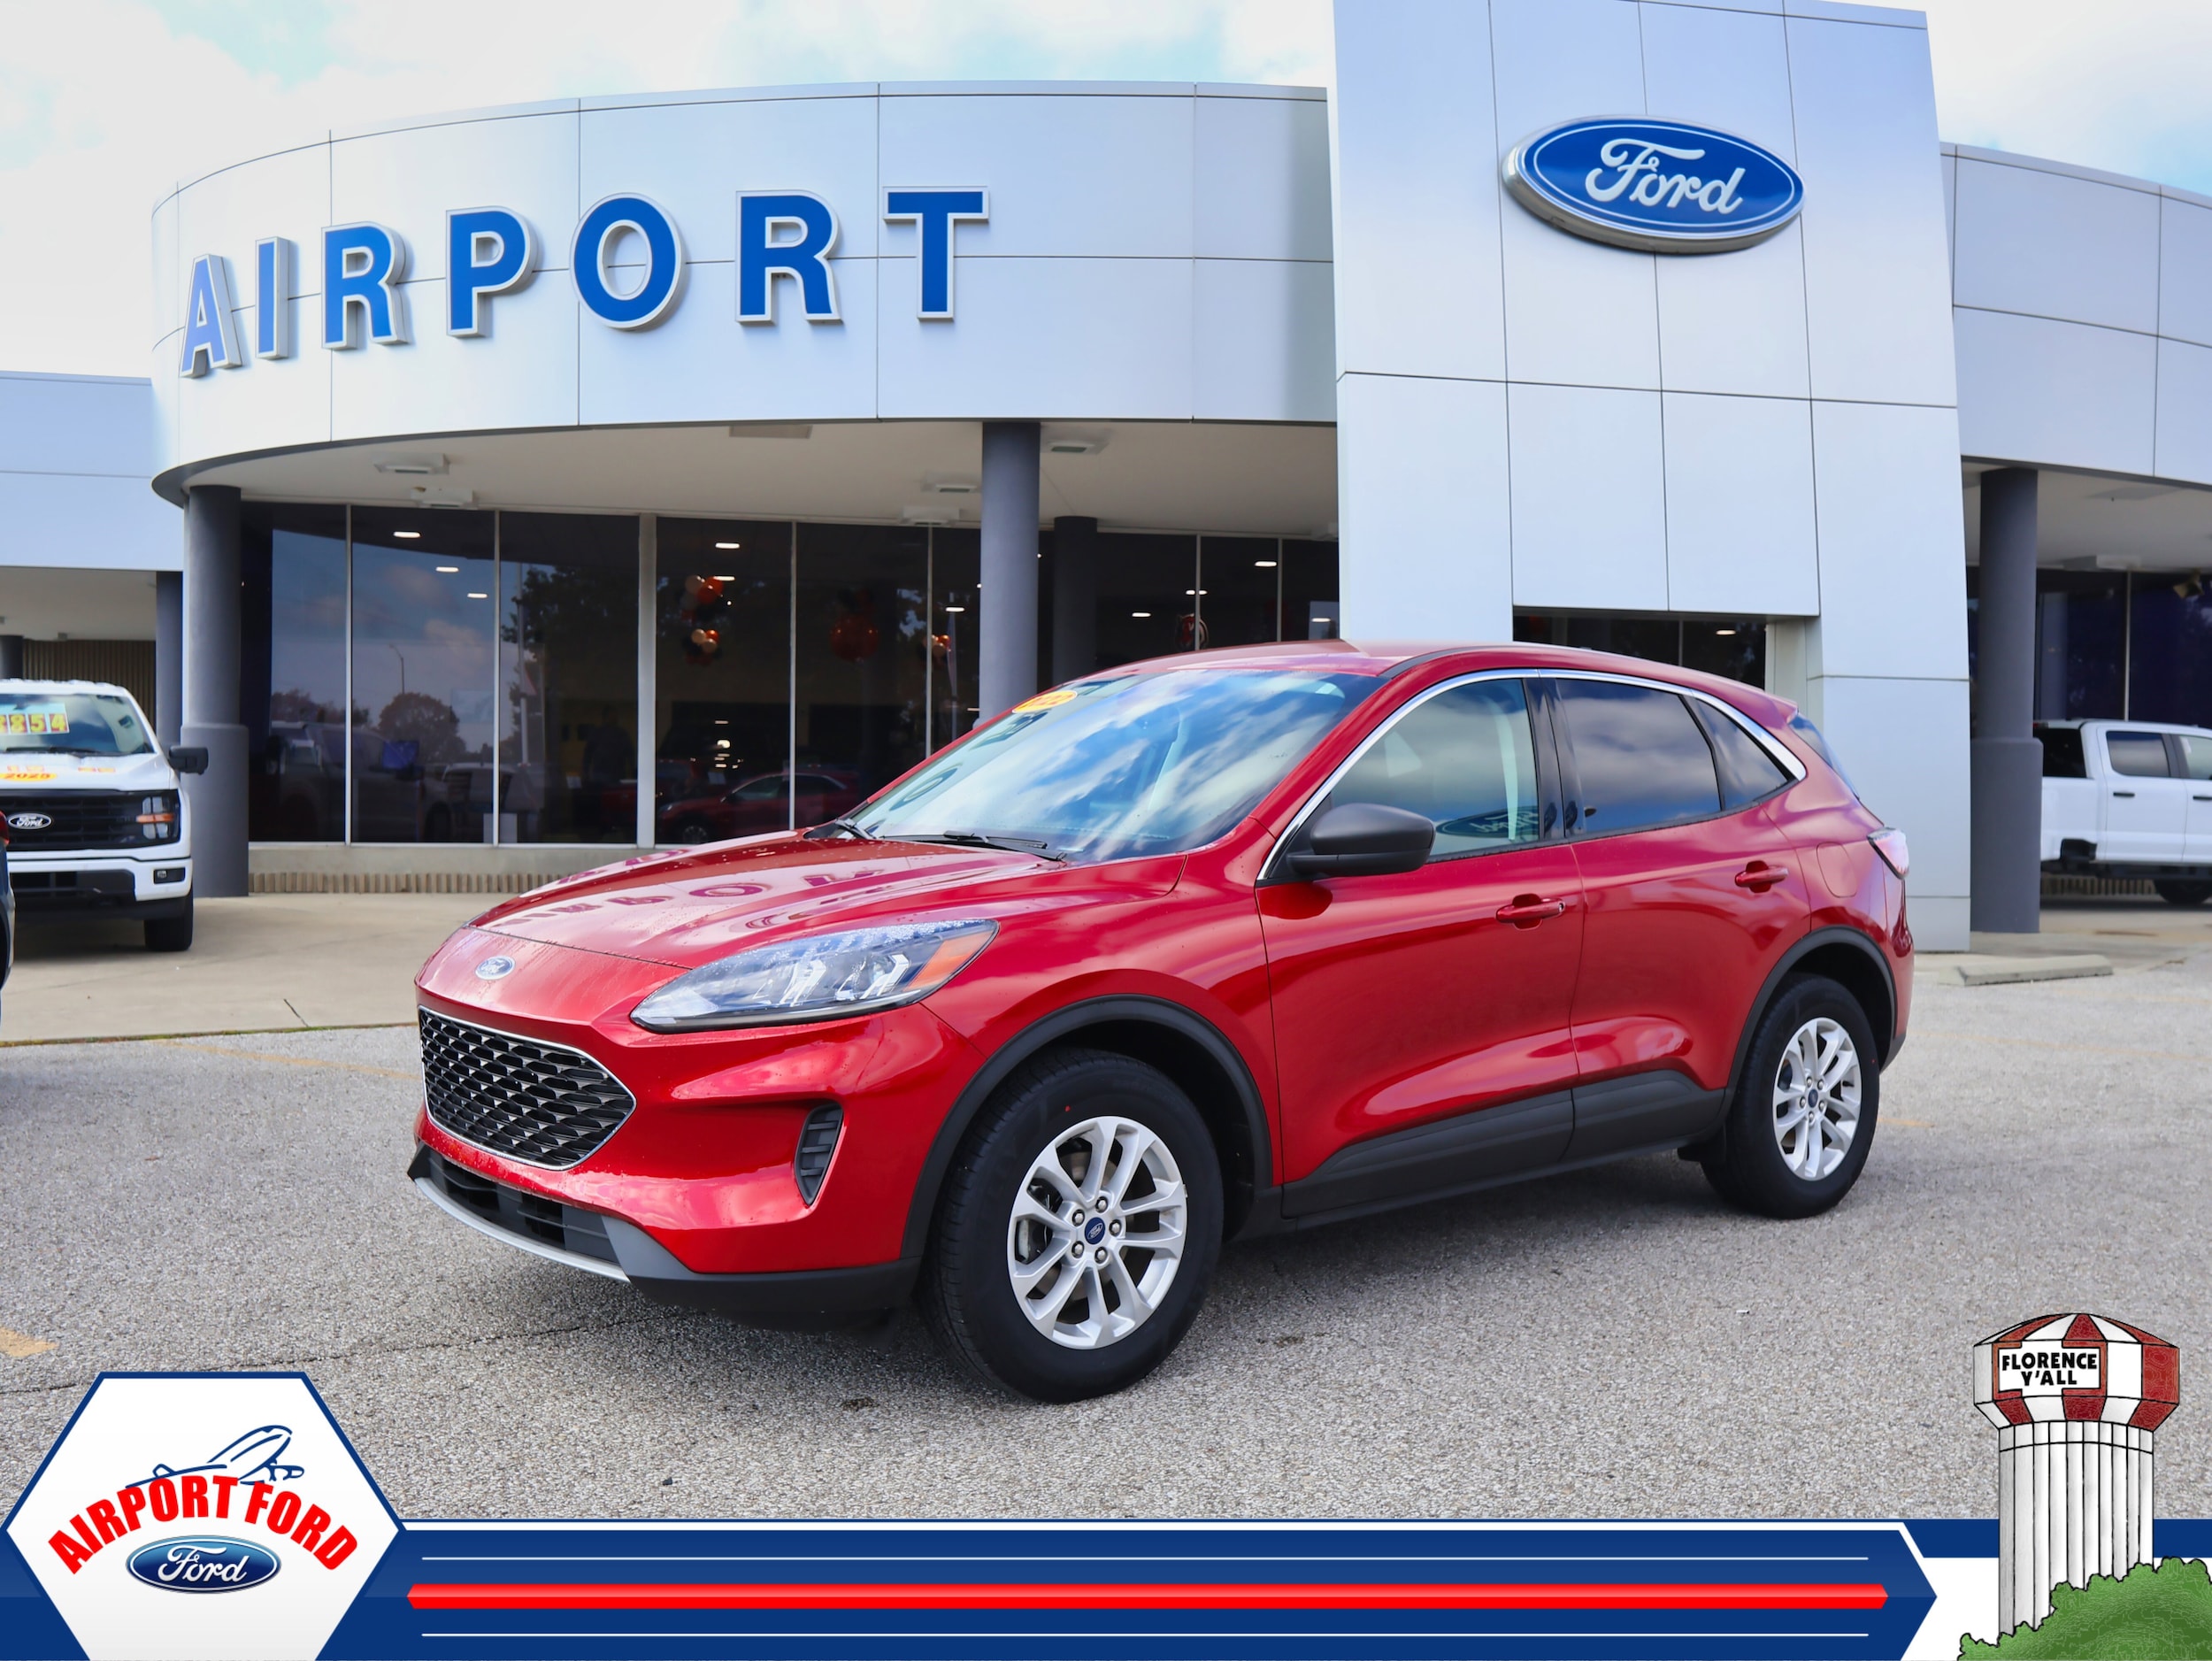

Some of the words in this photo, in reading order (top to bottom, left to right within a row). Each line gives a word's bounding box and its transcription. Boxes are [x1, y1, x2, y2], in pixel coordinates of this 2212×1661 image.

[1585, 138, 1746, 214] Ford
[178, 186, 987, 379] AIRPORT
[16, 814, 43, 827] Ford
